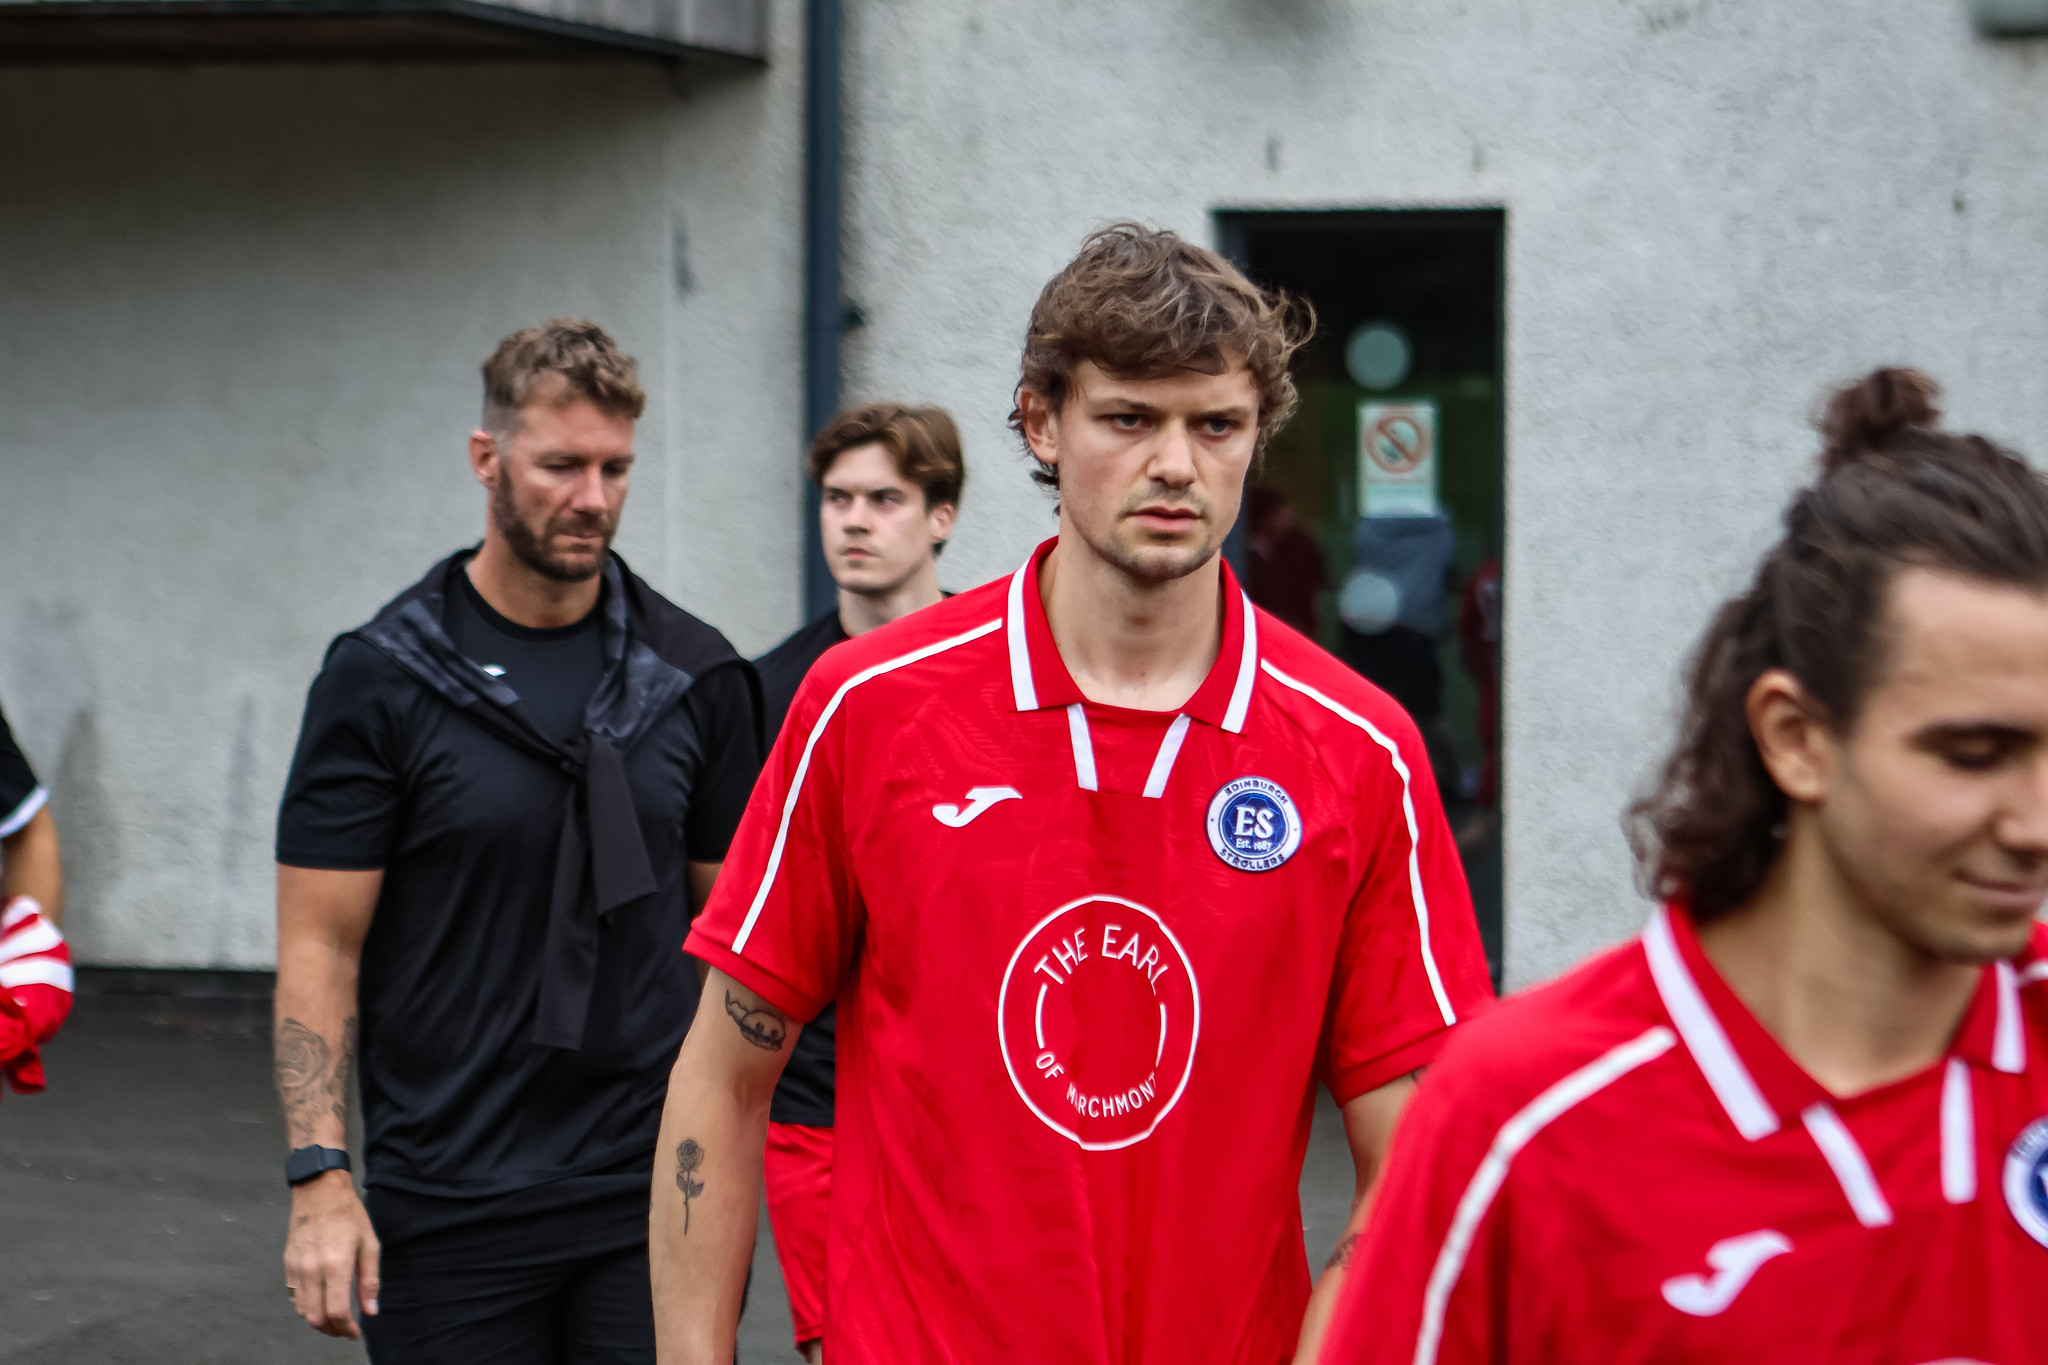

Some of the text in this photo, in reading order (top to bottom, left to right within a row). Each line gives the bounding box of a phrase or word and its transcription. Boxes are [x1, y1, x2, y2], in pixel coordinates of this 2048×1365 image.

[1224, 780, 1288, 804] EDINBURGH
[1234, 807, 1274, 838] ES
[1236, 838, 1251, 849] Est.
[1220, 849, 1285, 869] STROLLERS
[1034, 924, 1168, 995] THE EARL
[1035, 1052, 1064, 1079] OF
